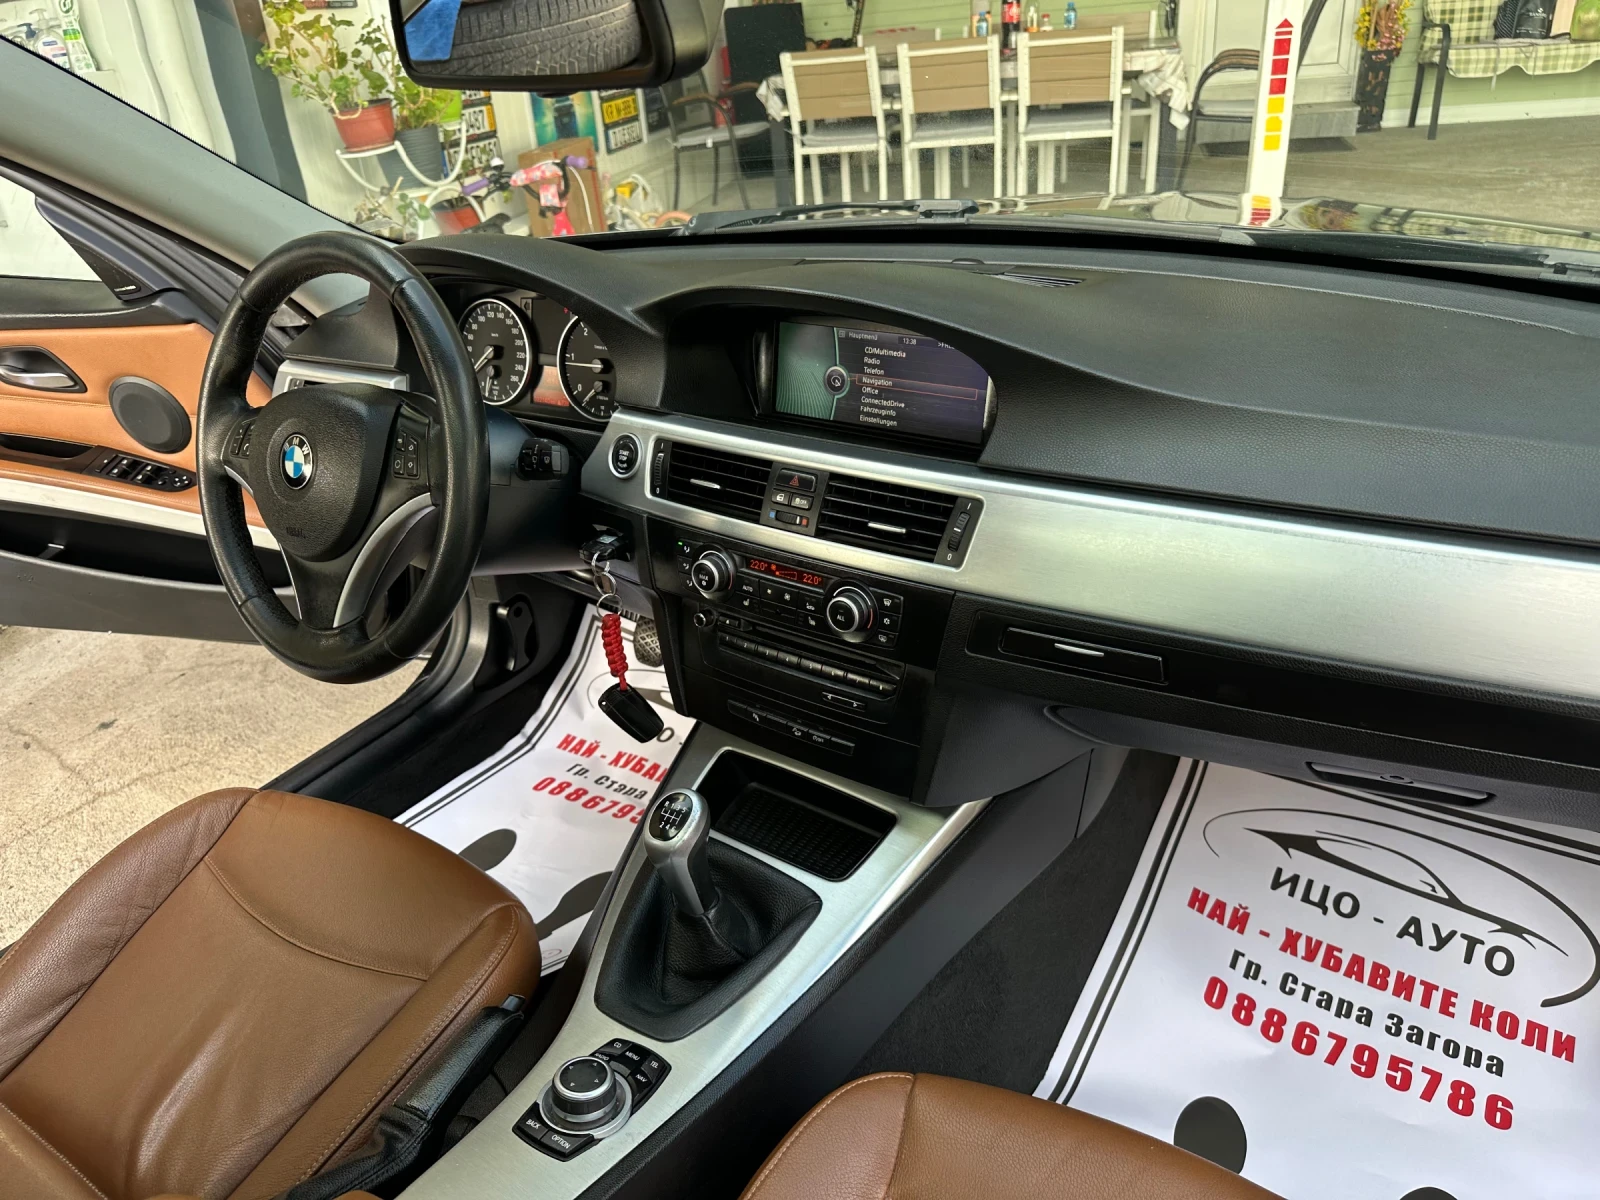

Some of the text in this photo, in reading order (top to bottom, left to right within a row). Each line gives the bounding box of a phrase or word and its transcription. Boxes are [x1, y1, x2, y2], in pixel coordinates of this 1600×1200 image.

[471, 323, 478, 331] 80
[511, 327, 520, 335] 180
[583, 327, 589, 336] 2
[467, 333, 474, 341] 60
[516, 351, 526, 359] 220
[571, 352, 575, 361] 1
[863, 356, 881, 365] Radio
[514, 363, 524, 371] 240
[863, 366, 885, 375] Telefon
[510, 375, 519, 383] 260
[862, 376, 893, 387] Navigation
[577, 383, 582, 392] 0
[861, 386, 879, 395] Office
[861, 395, 906, 408] ConnectedDrive
[860, 405, 897, 417] Fahrzeuginfo
[859, 414, 898, 427] Einstellungen
[618, 449, 630, 457] START
[836, 614, 846, 622] ALL
[557, 733, 601, 758] НАЙ
[566, 763, 649, 800] Гр. Стара
[1269, 867, 1361, 920] ИЦО
[1395, 915, 1516, 977] АУТО
[1186, 887, 1251, 935] НАЙ
[1278, 927, 1459, 1019] ХУБАВИТЕ
[1469, 999, 1577, 1063] КОЛИ
[1228, 949, 1505, 1078] Гр. Стара Загора
[613, 1041, 622, 1049] CD
[594, 1052, 610, 1061] RADIO
[625, 1050, 640, 1061] MENU
[1203, 975, 1515, 1131] 0886795786
[650, 1060, 659, 1069] TEL
[635, 1073, 648, 1083] NAV
[525, 1118, 541, 1130] BACK
[551, 1134, 571, 1149] OPTION
